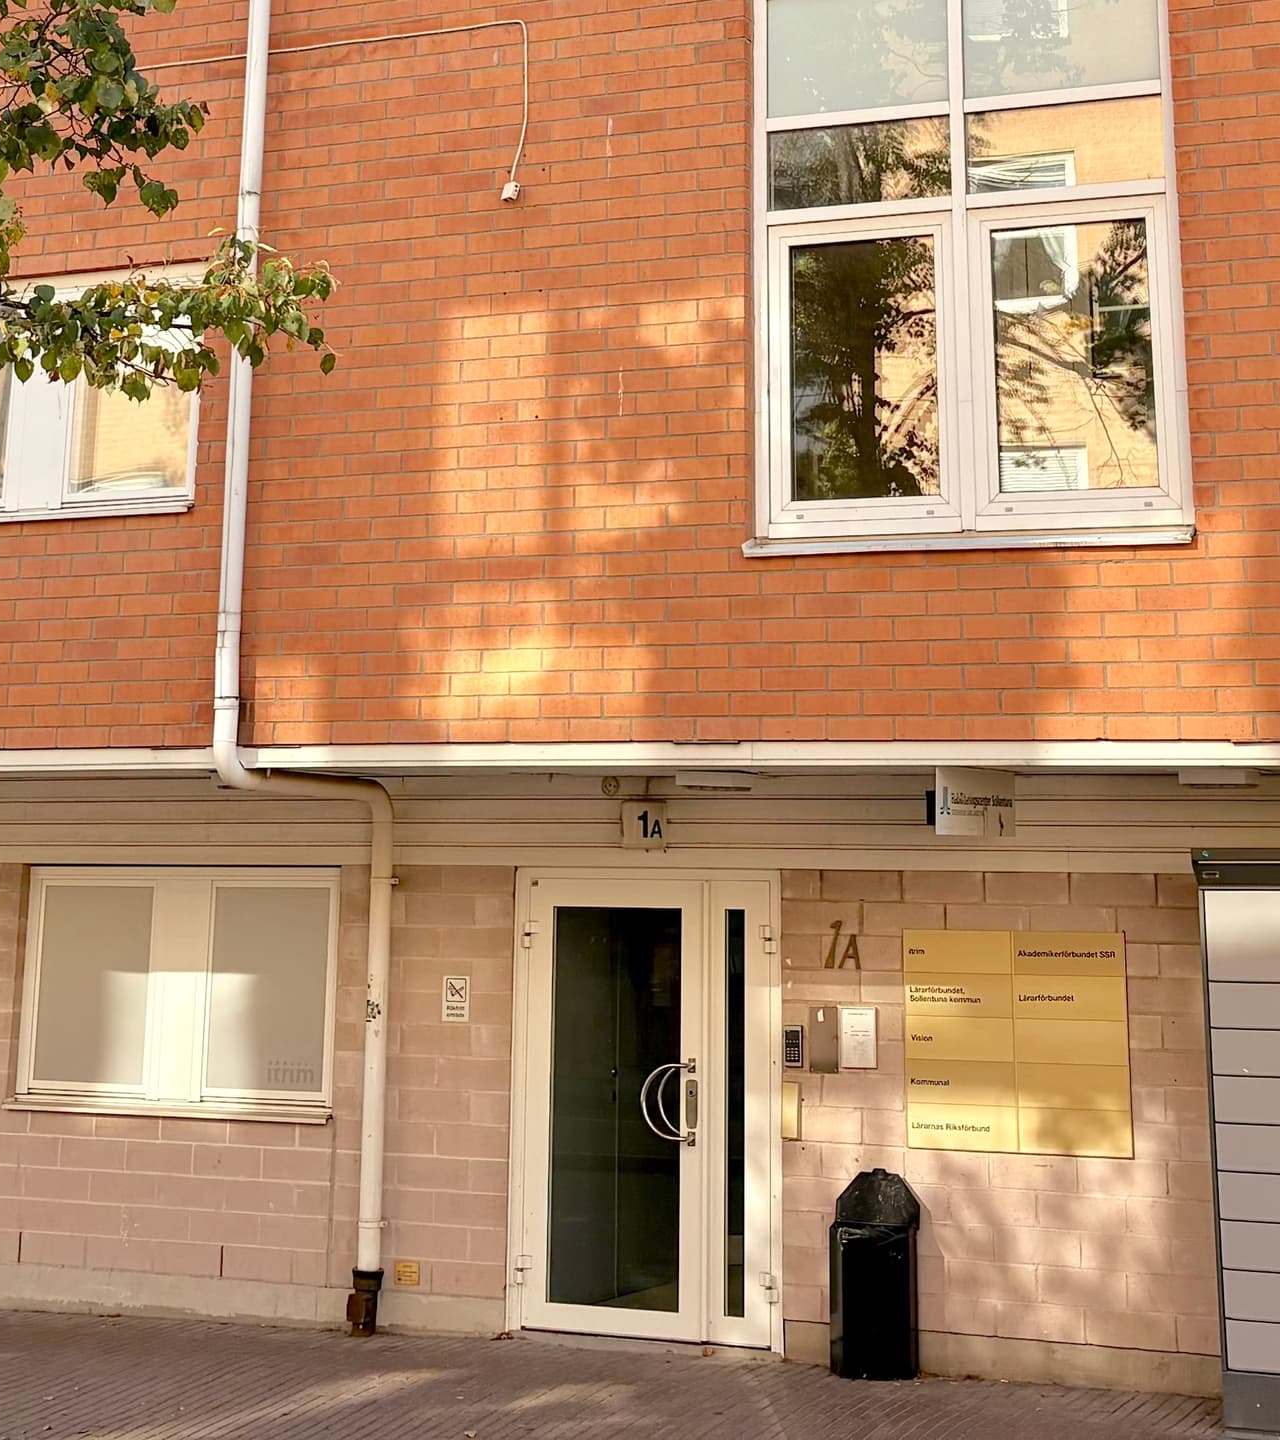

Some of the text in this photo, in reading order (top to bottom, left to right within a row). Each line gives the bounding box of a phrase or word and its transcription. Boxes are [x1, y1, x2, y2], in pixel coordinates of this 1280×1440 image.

[637, 810, 663, 838] 1A
[824, 920, 862, 970] 1A
[910, 994, 981, 1004] Sollentuna kommun
[1018, 994, 1075, 1002] Lärarförbundet
[910, 1033, 933, 1042] Vision
[910, 1077, 950, 1086] Kommunal
